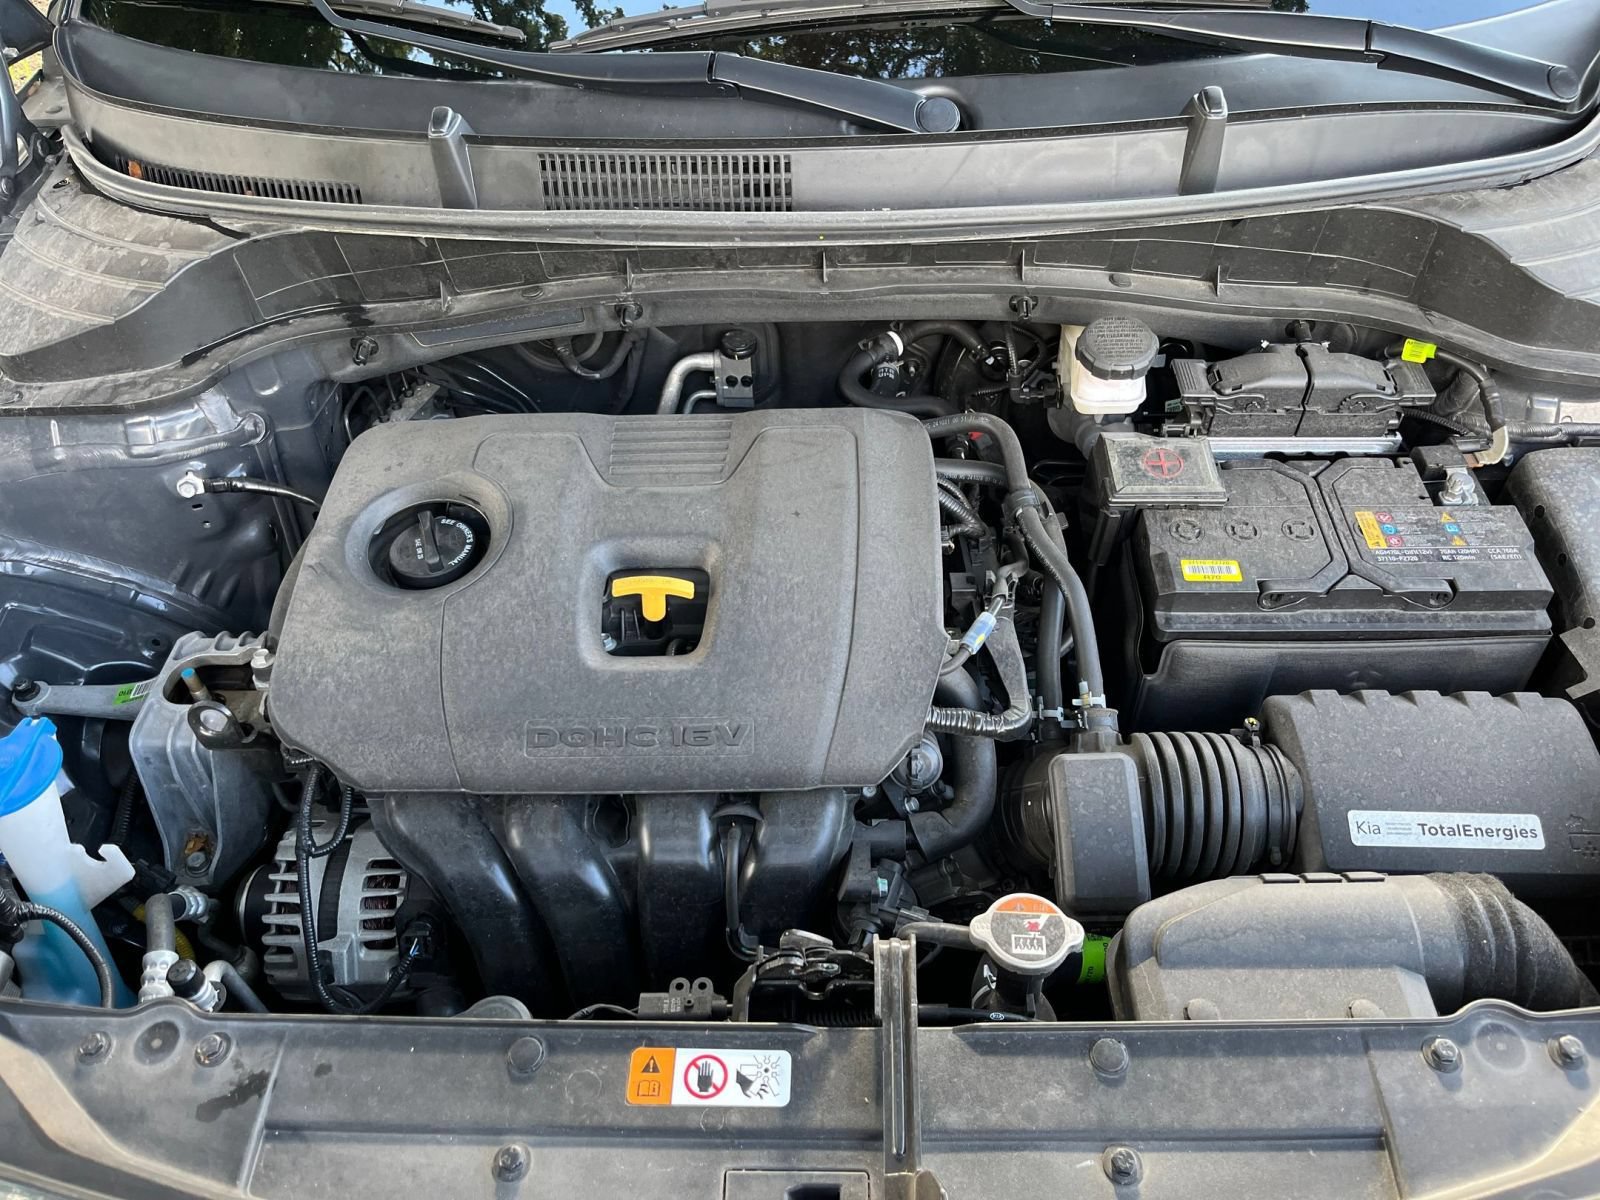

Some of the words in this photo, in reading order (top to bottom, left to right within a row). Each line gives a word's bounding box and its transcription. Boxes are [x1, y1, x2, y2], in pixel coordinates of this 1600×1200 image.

[441, 518, 456, 526] SEE
[447, 544, 472, 566] MANUAL
[525, 724, 660, 749] DOHC
[671, 721, 751, 748] 16V
[1355, 820, 1382, 835] Kia
[1416, 822, 1539, 841] TotalEnergies
